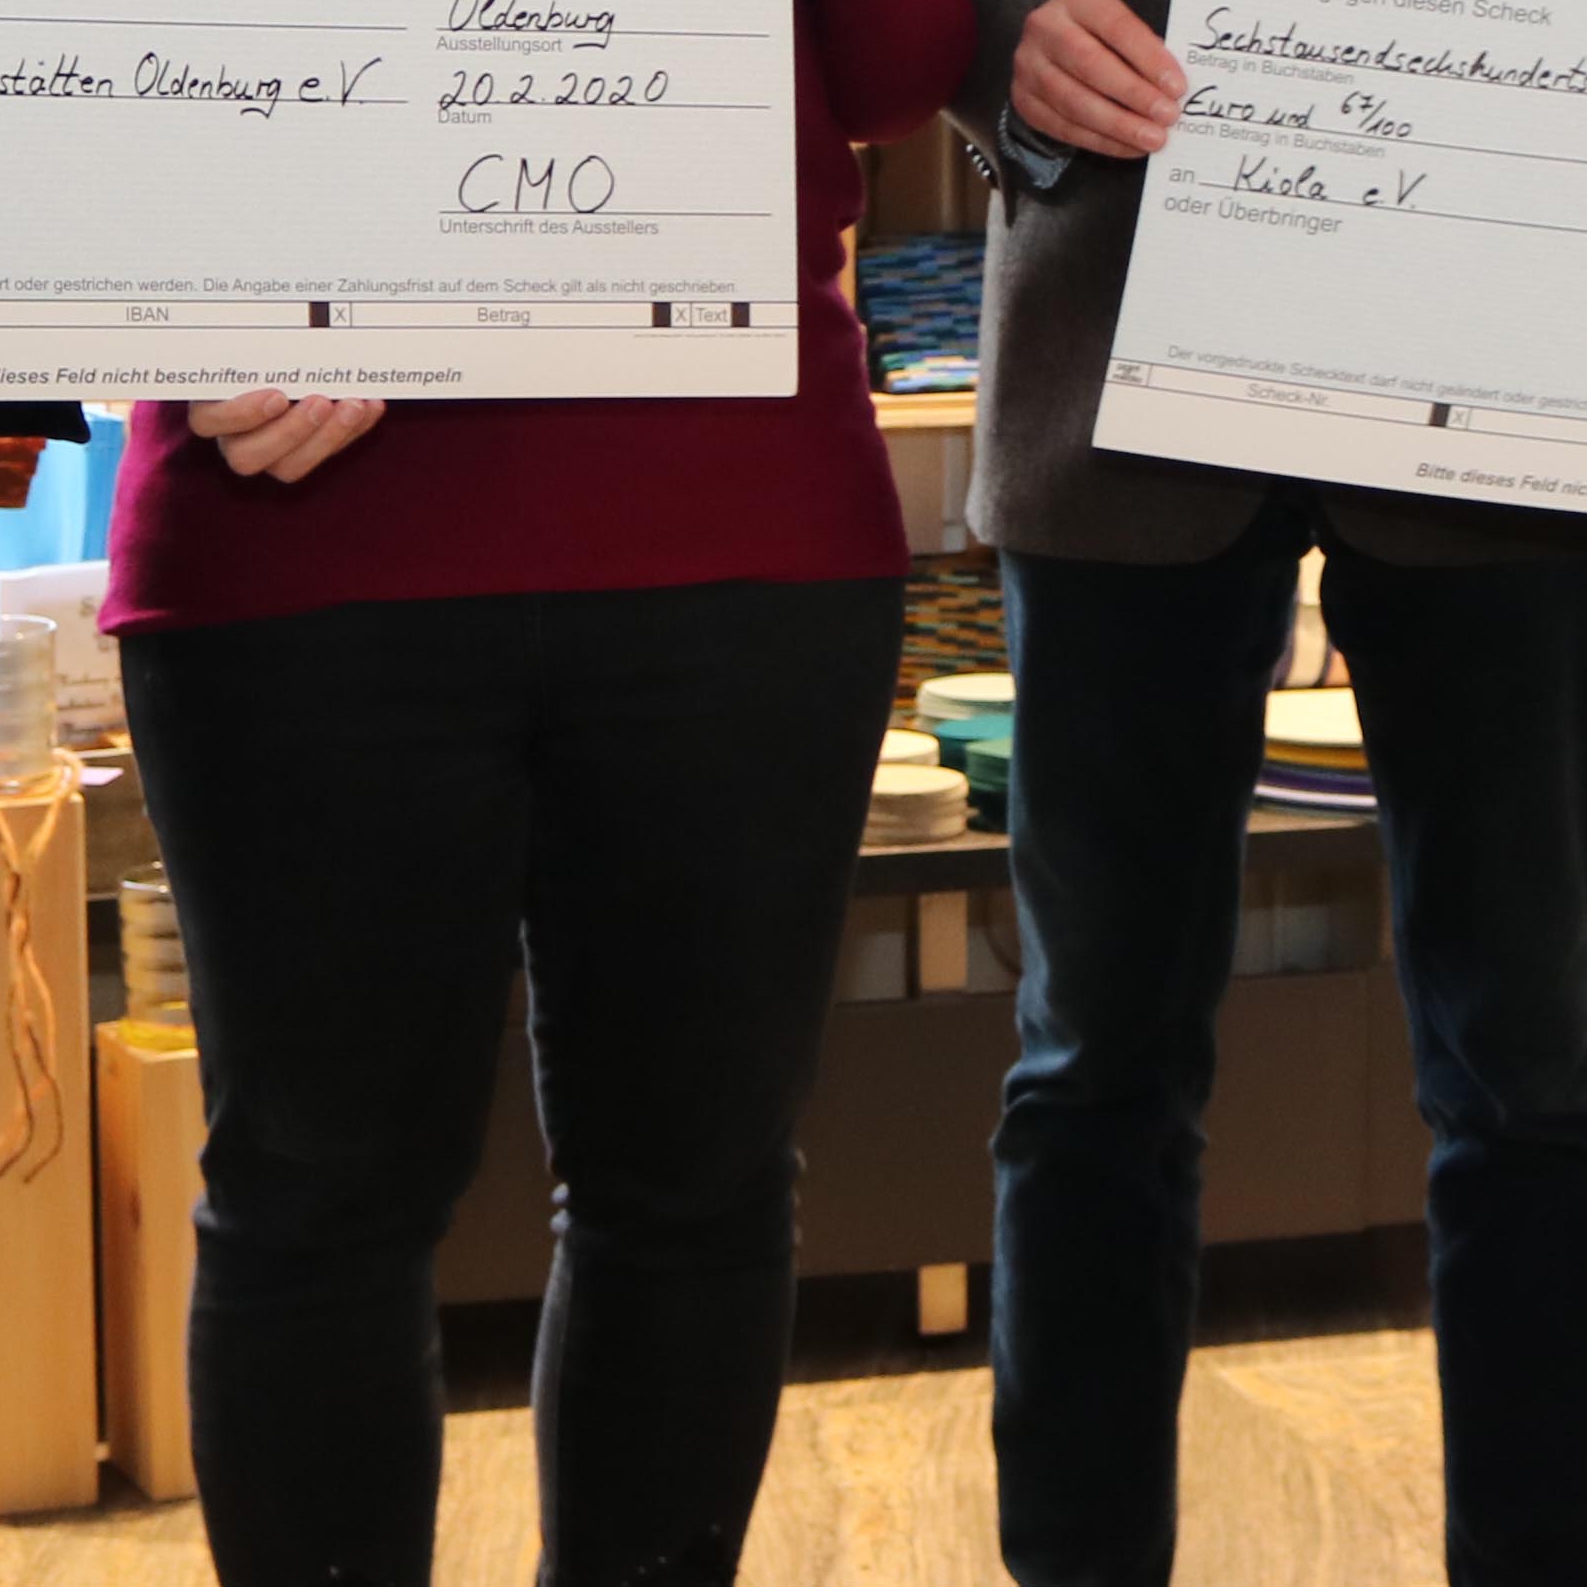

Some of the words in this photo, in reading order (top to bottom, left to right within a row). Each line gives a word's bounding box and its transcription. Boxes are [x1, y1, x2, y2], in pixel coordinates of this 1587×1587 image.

[1471, 0, 1552, 26] Scheck
[436, 35, 563, 55] Ausstellungsort
[1187, 51, 1238, 74] Betrag
[1242, 58, 1257, 72] in
[1261, 60, 1355, 86] Buchstaben
[134, 51, 282, 118] Oldenburg
[437, 108, 492, 125] Datum
[1180, 84, 1255, 119] Euro
[1265, 103, 1314, 130] und
[1177, 118, 1215, 136] noch
[1218, 122, 1271, 146] Betrag
[1275, 130, 1289, 145] in
[1293, 132, 1386, 159] Buchstaben
[1168, 166, 1196, 183] an
[1232, 153, 1329, 201] Kiola
[1163, 196, 1213, 217] oder
[1217, 197, 1344, 235] Überbringer
[439, 218, 535, 236] Unterschrift
[539, 218, 568, 236] des
[571, 219, 660, 237] Ausstellers
[14, 276, 49, 292] oder
[53, 276, 133, 295] gestrichen
[138, 277, 198, 293] werden.
[203, 278, 228, 293] Die
[232, 278, 290, 296] Angabe
[295, 279, 332, 293] einer
[337, 278, 434, 296] Zahlungsfrist
[438, 279, 462, 293] auf
[466, 279, 499, 294] dem
[503, 279, 557, 294] Scheck
[561, 279, 582, 296] gilt
[586, 279, 607, 294] als
[611, 280, 645, 294] nicht
[125, 306, 170, 322] IBAN
[334, 307, 347, 322] X
[476, 307, 531, 326] Betrag
[674, 308, 687, 322] X
[695, 307, 728, 323] Text
[55, 368, 96, 385] Feld
[101, 368, 149, 385] nicht
[153, 367, 259, 385] beschriften
[264, 368, 300, 384] und
[305, 367, 352, 384] nicht
[356, 367, 462, 387] bestempeln
[1452, 410, 1464, 425] X
[1415, 462, 1456, 481] Bitte
[1460, 468, 1516, 488] dieses
[1519, 475, 1559, 494] Feld
